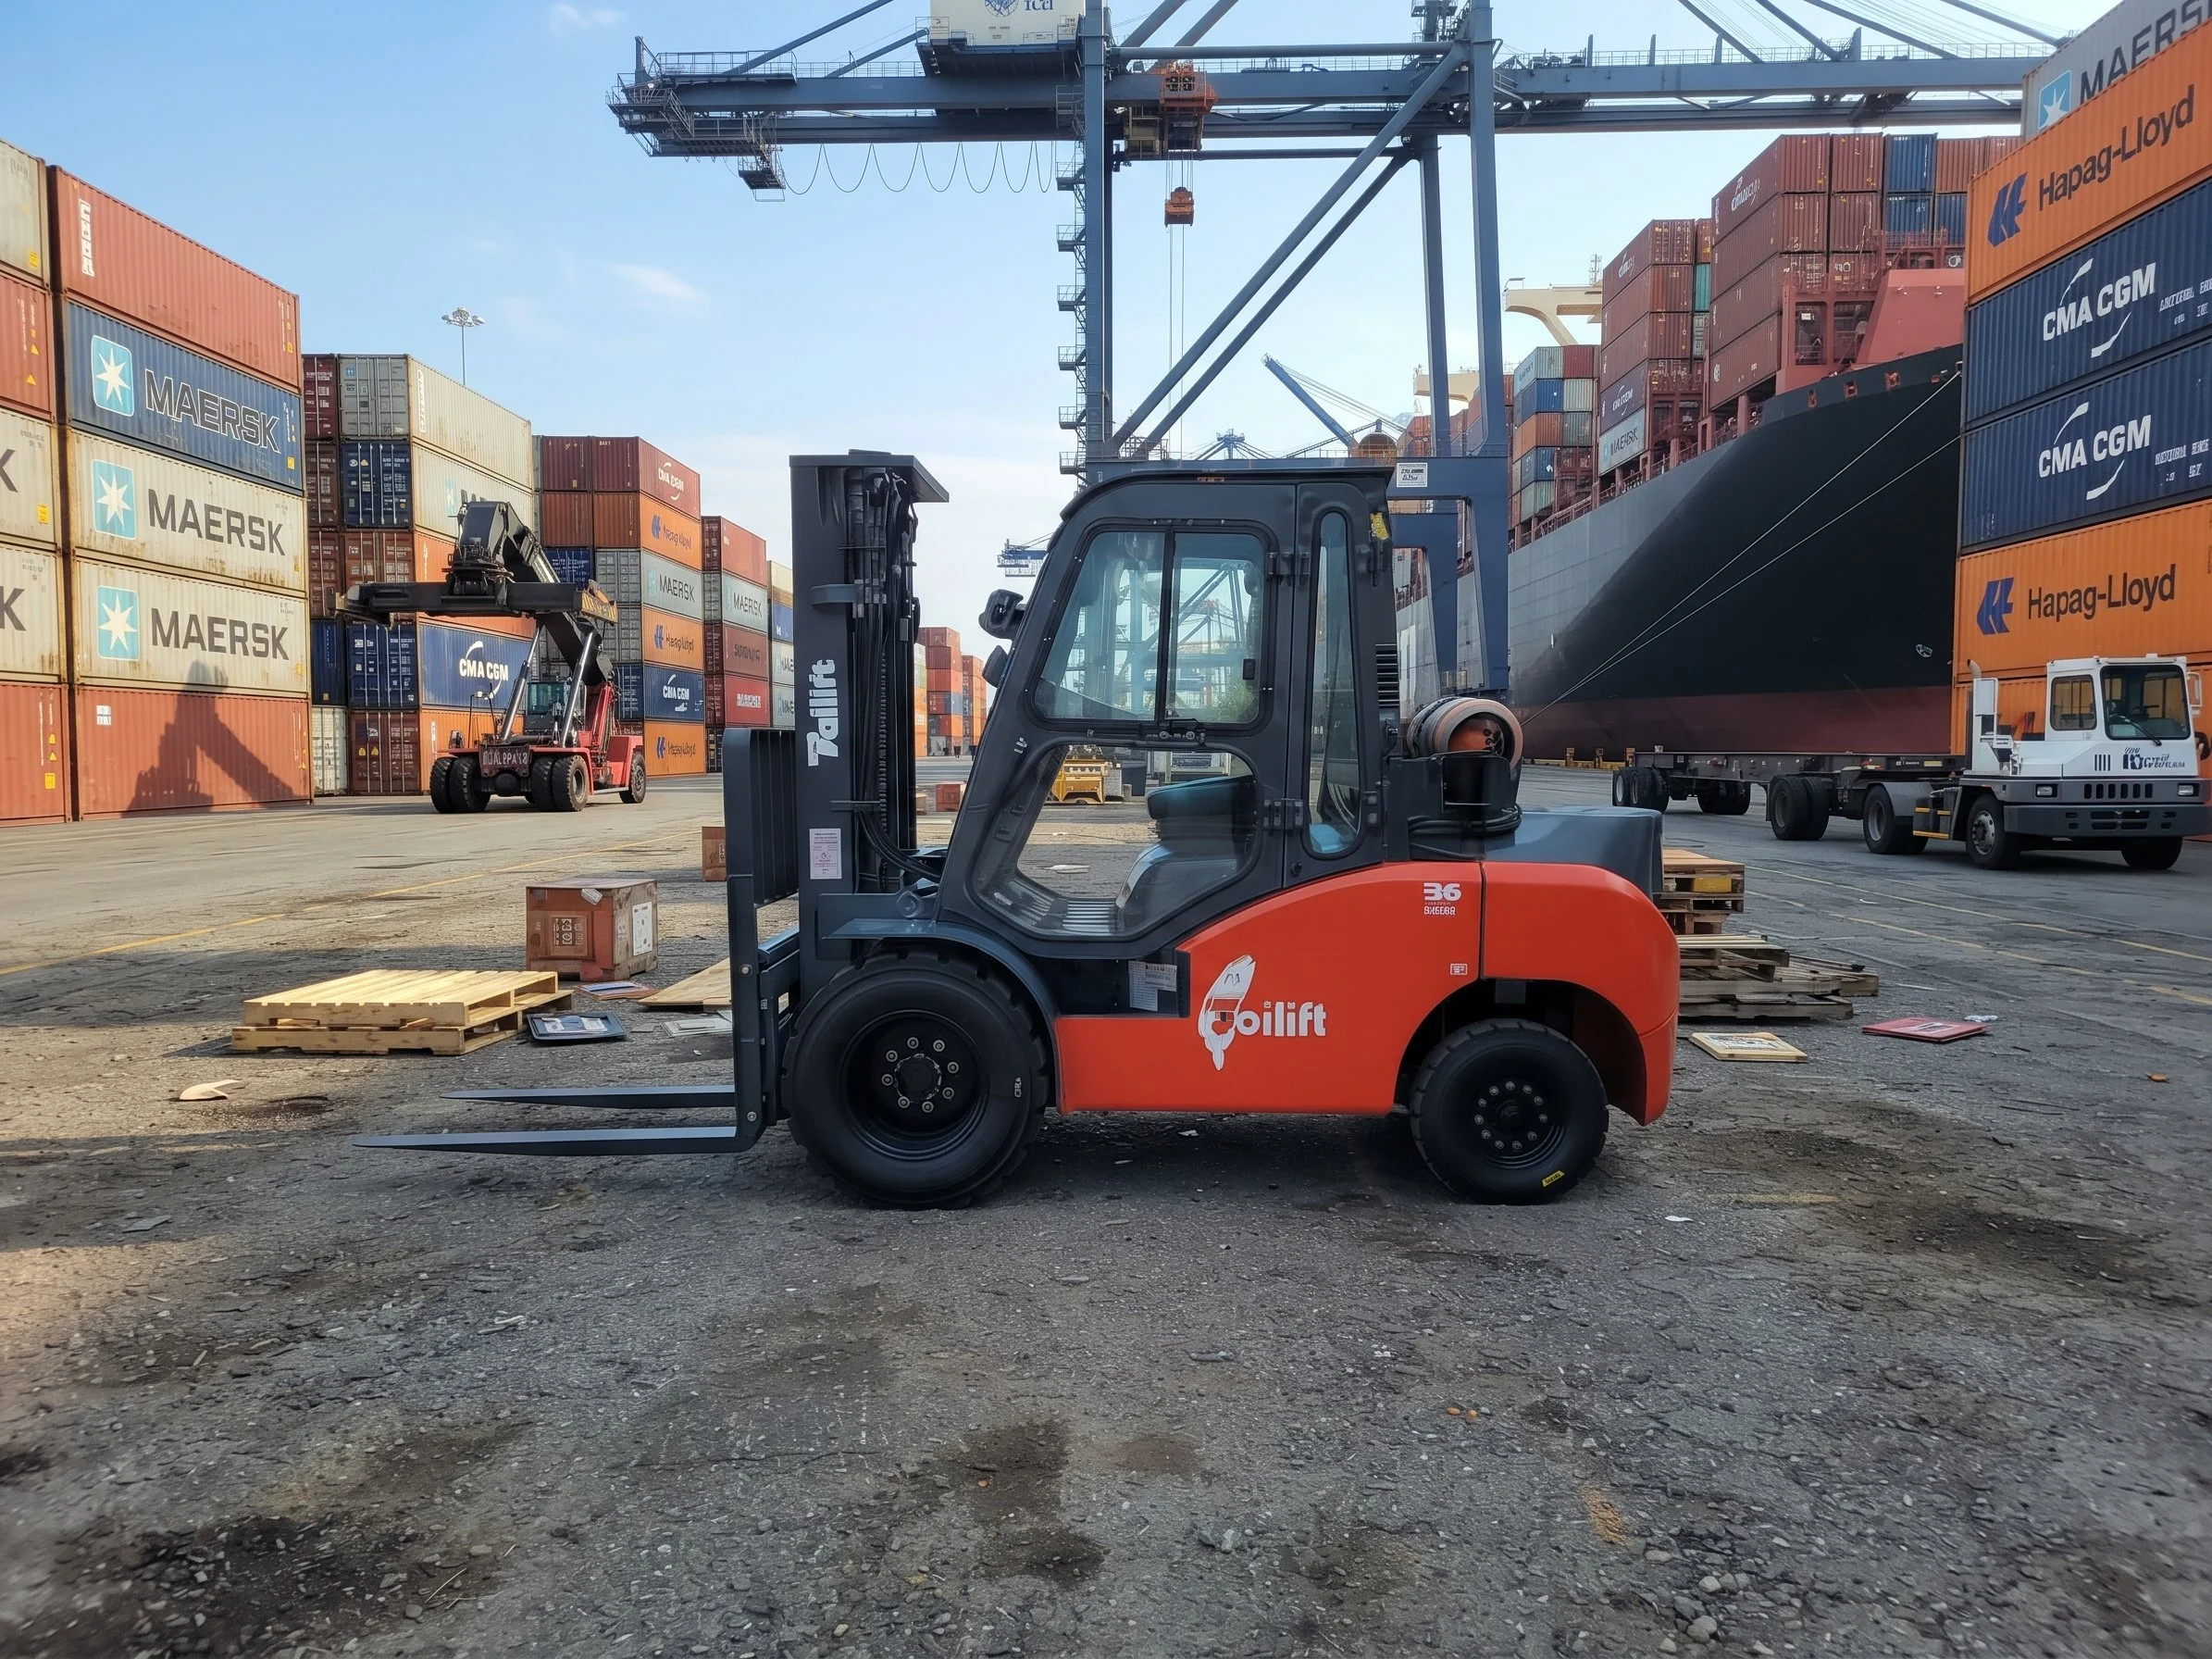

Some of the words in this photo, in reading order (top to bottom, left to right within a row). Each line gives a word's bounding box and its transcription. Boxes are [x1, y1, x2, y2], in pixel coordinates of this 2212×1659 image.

[2039, 83, 2194, 211] Hapag-Lloyd
[2043, 294, 2093, 342] CMA
[2096, 262, 2156, 318] CGM
[144, 368, 281, 454] MAERSK
[2038, 438, 2087, 479] CMA
[2093, 414, 2152, 462] CGM
[148, 488, 286, 555] MAERSK
[659, 573, 695, 603] MAERSK
[2028, 563, 2176, 622] Hapag-Lloyd
[151, 607, 289, 660] MAERSK
[459, 658, 485, 679] CMA
[486, 662, 509, 681] CGM
[1423, 882, 1461, 902] 36
